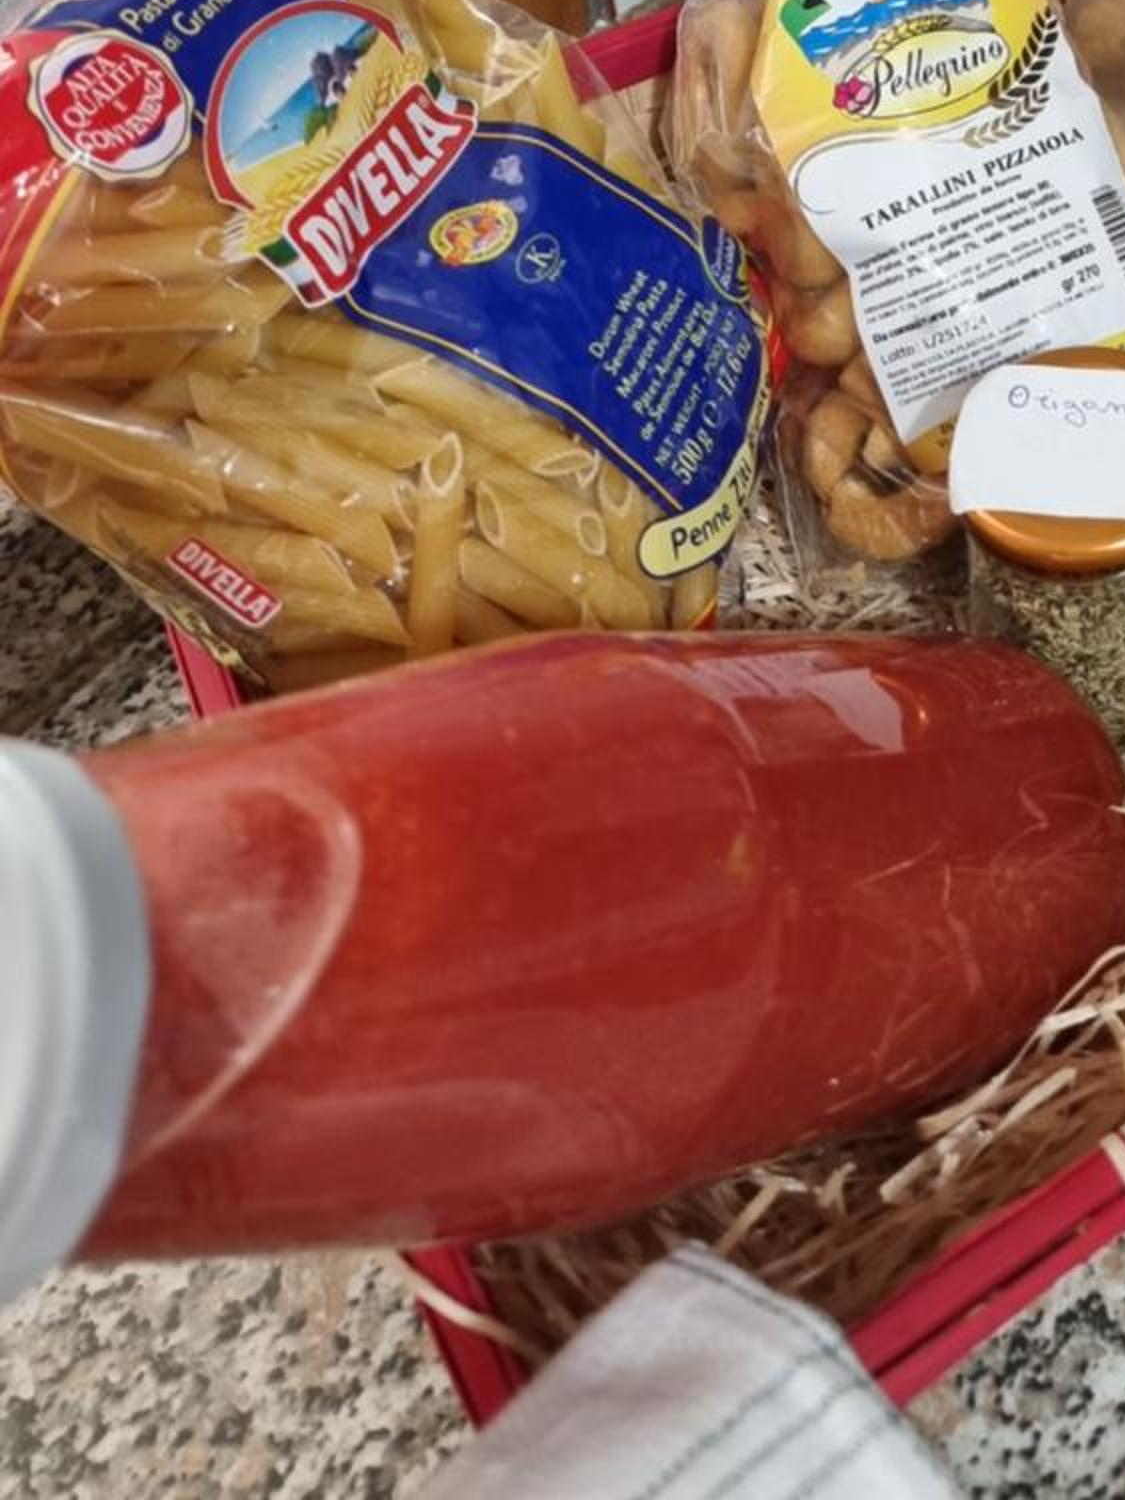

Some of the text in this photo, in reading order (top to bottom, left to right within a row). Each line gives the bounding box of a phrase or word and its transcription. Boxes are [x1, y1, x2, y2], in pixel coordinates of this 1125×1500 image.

[66, 52, 118, 99] ALTA
[163, 33, 182, 52] di
[866, 40, 1004, 116] Pellegrino
[62, 52, 150, 129] QUALITÀ
[75, 68, 166, 152] CONVENIENZA
[299, 102, 462, 277] DIVELLA
[861, 127, 1085, 231] TARALLINI PIZZAIOLA
[1076, 263, 1101, 283] 270
[589, 270, 647, 357] Durum Wheat
[605, 278, 667, 374] Semolina Pasta
[616, 287, 685, 396] Macaroni Product
[711, 352, 749, 395] 17.6
[670, 502, 734, 559] Penne
[175, 541, 275, 621] DIVELLA
